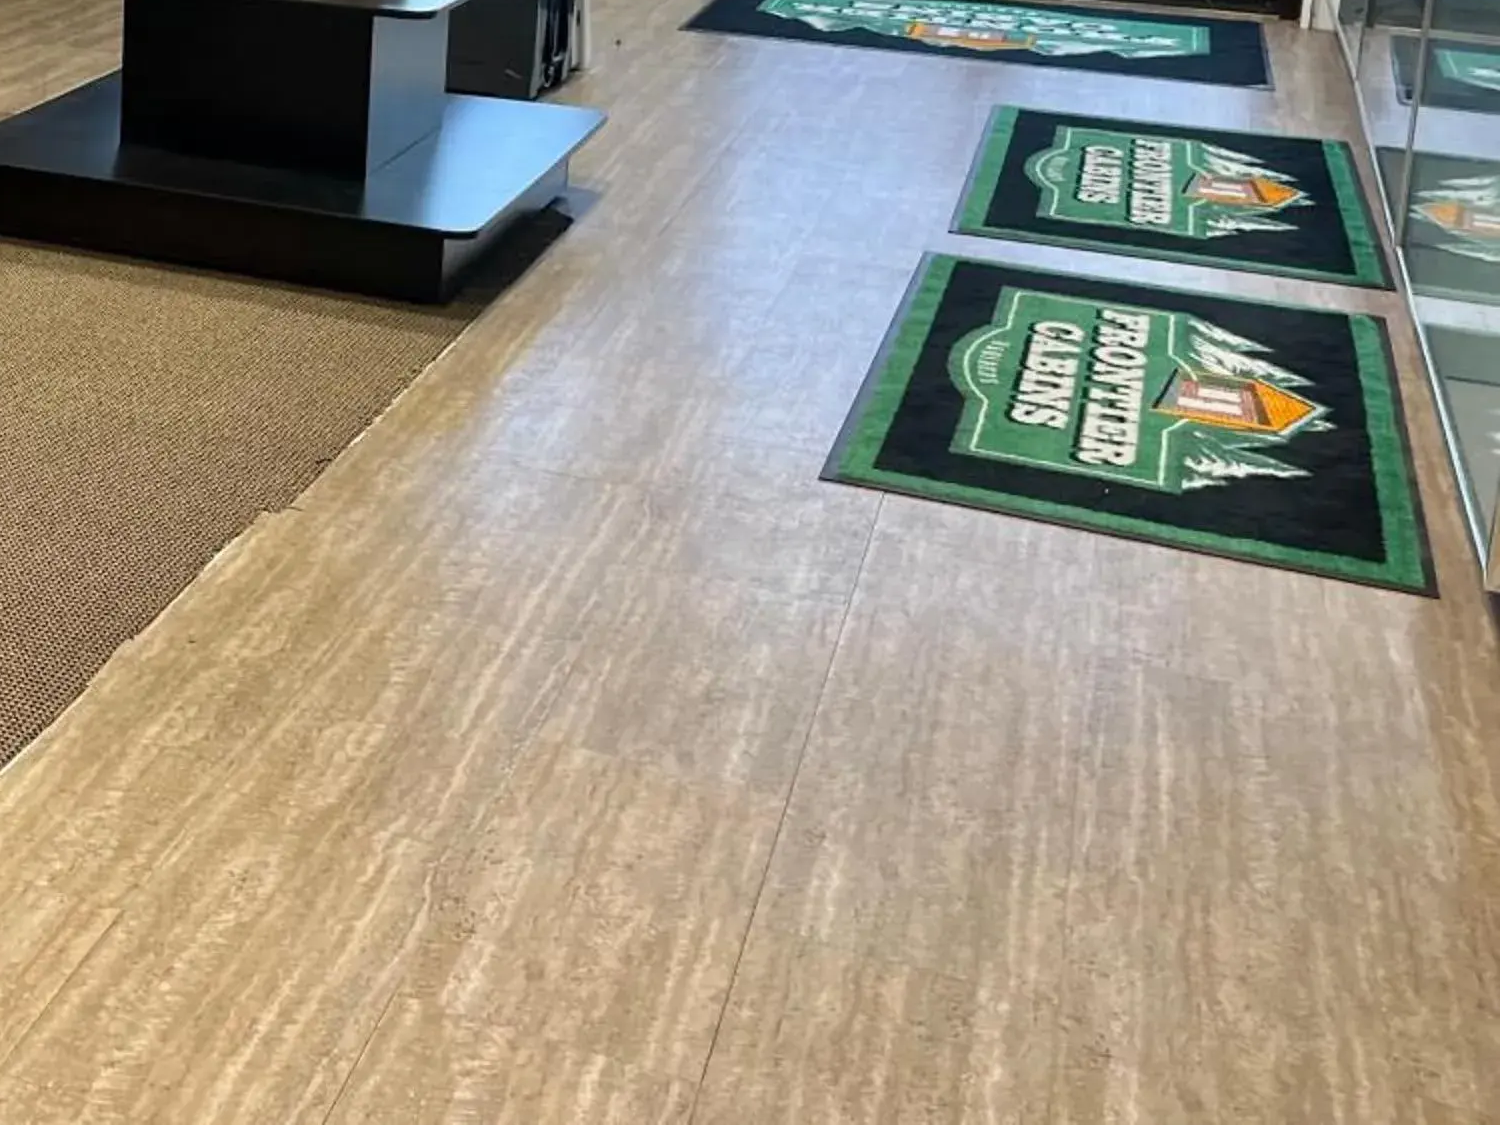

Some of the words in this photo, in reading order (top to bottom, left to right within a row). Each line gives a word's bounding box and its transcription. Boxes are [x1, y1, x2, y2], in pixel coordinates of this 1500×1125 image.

[1077, 145, 1125, 204] CABINS
[1129, 138, 1173, 225] FRONTIER
[1010, 320, 1085, 429] CABINS
[1077, 309, 1150, 466] FRONTIER
